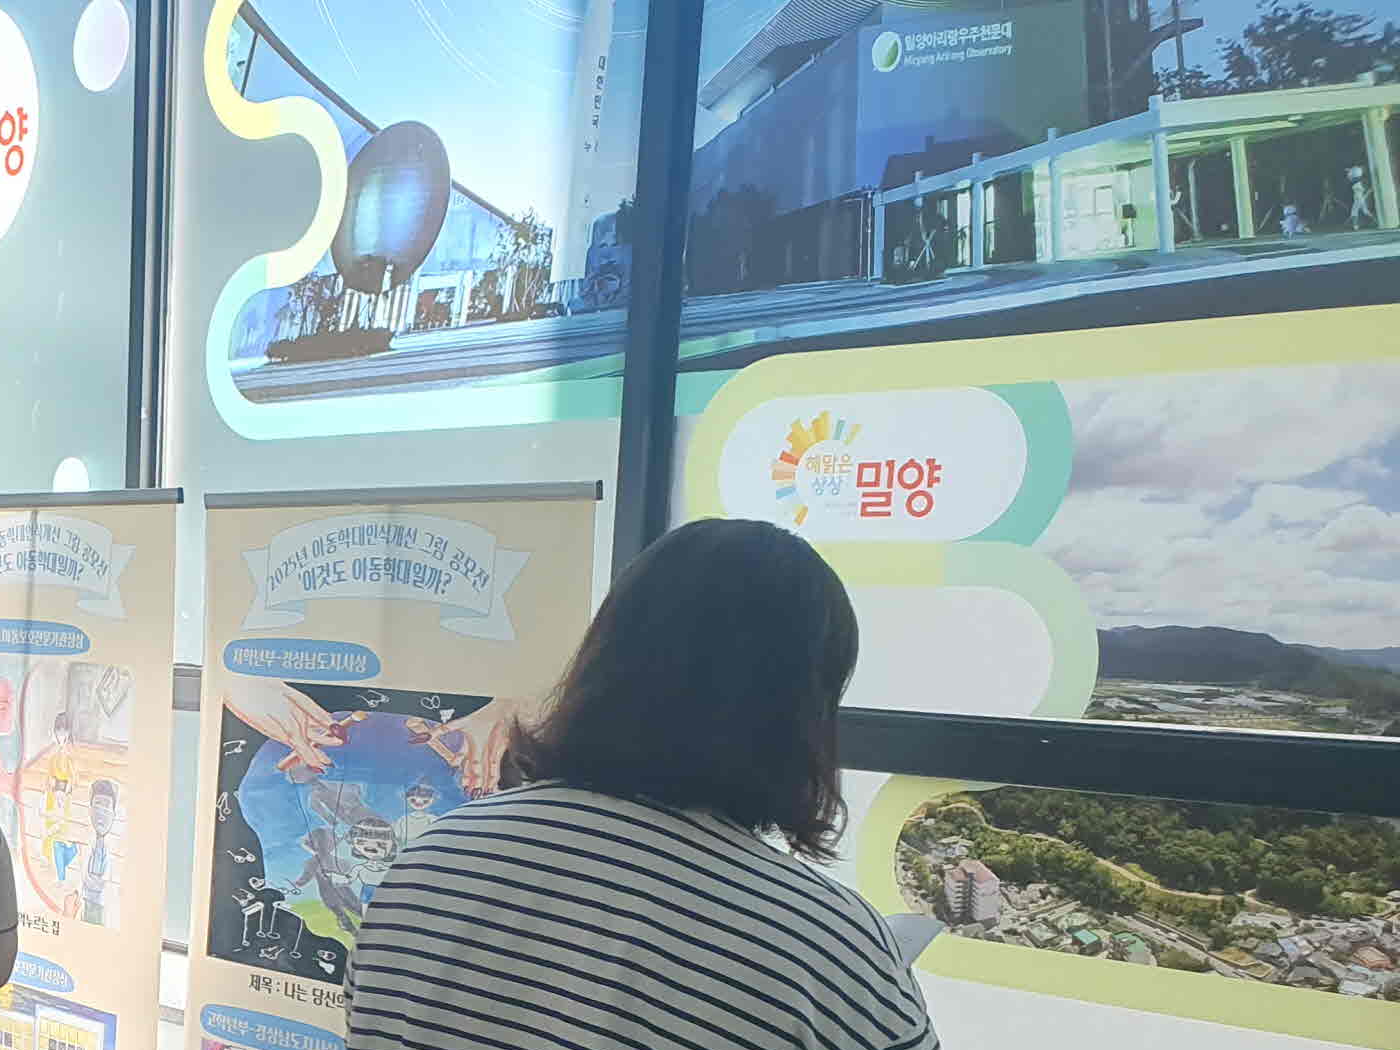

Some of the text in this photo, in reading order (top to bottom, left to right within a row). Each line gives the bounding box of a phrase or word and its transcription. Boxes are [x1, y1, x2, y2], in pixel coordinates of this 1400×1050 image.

[904, 21, 1013, 51] 밀양아리랑우주천문대
[805, 453, 852, 474] 해맑은
[856, 458, 942, 518] 밀양
[419, 532, 448, 561] 그림
[449, 548, 490, 593] 공모전
[249, 974, 273, 994] 제목
[284, 981, 307, 1002] 나는
